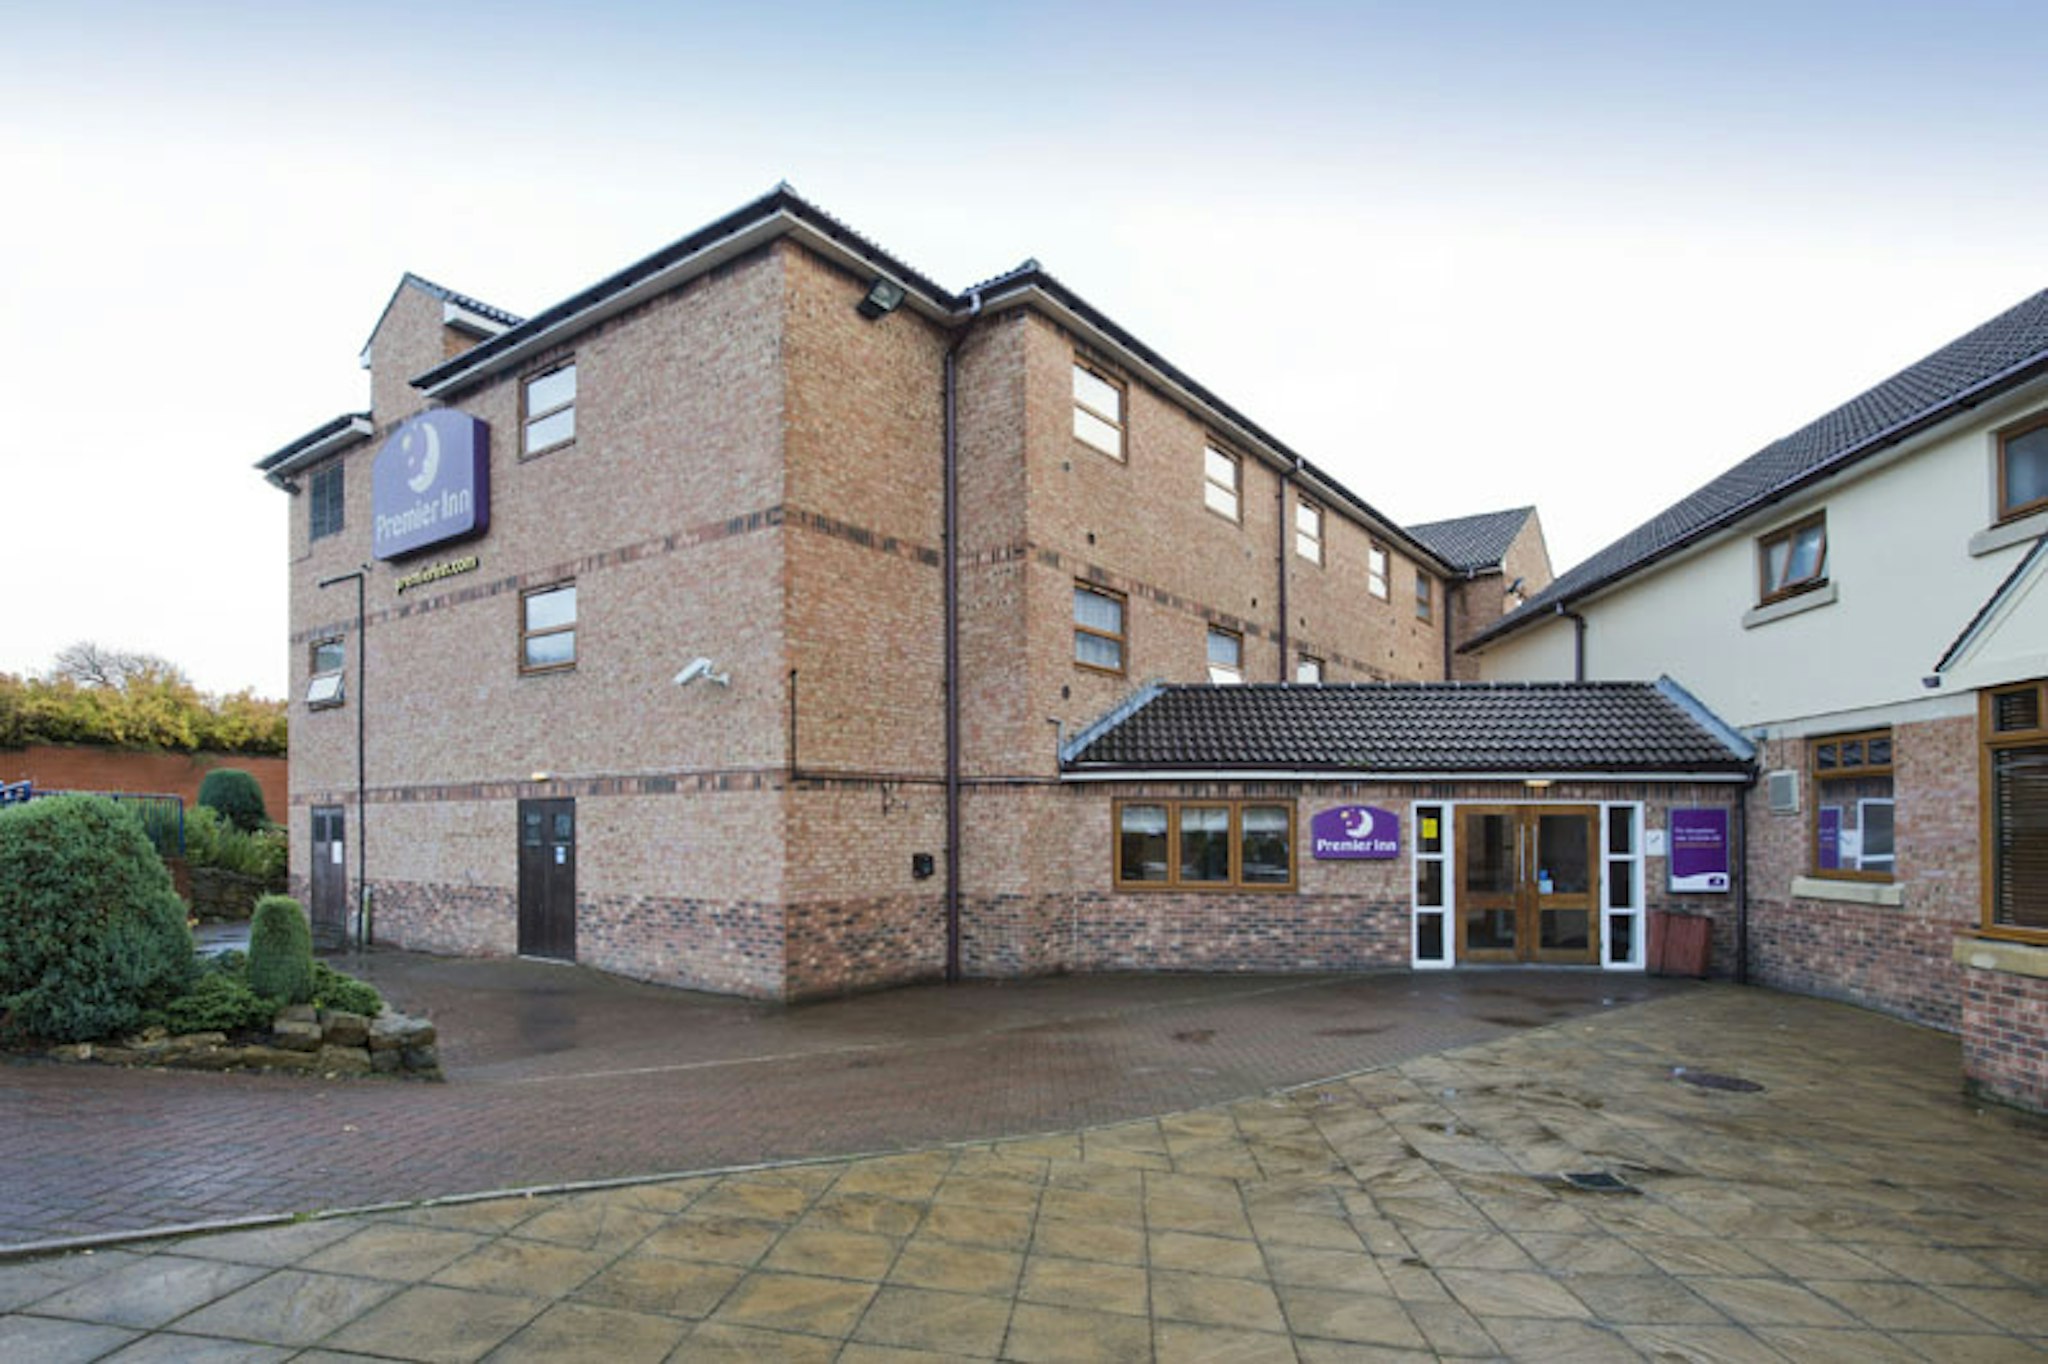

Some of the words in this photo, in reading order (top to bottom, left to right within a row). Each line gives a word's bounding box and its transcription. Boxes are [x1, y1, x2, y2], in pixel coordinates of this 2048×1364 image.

[377, 500, 439, 541] Premier
[442, 489, 469, 518] Inn
[1316, 838, 1373, 852] Premier
[1374, 838, 1397, 852] Inn
